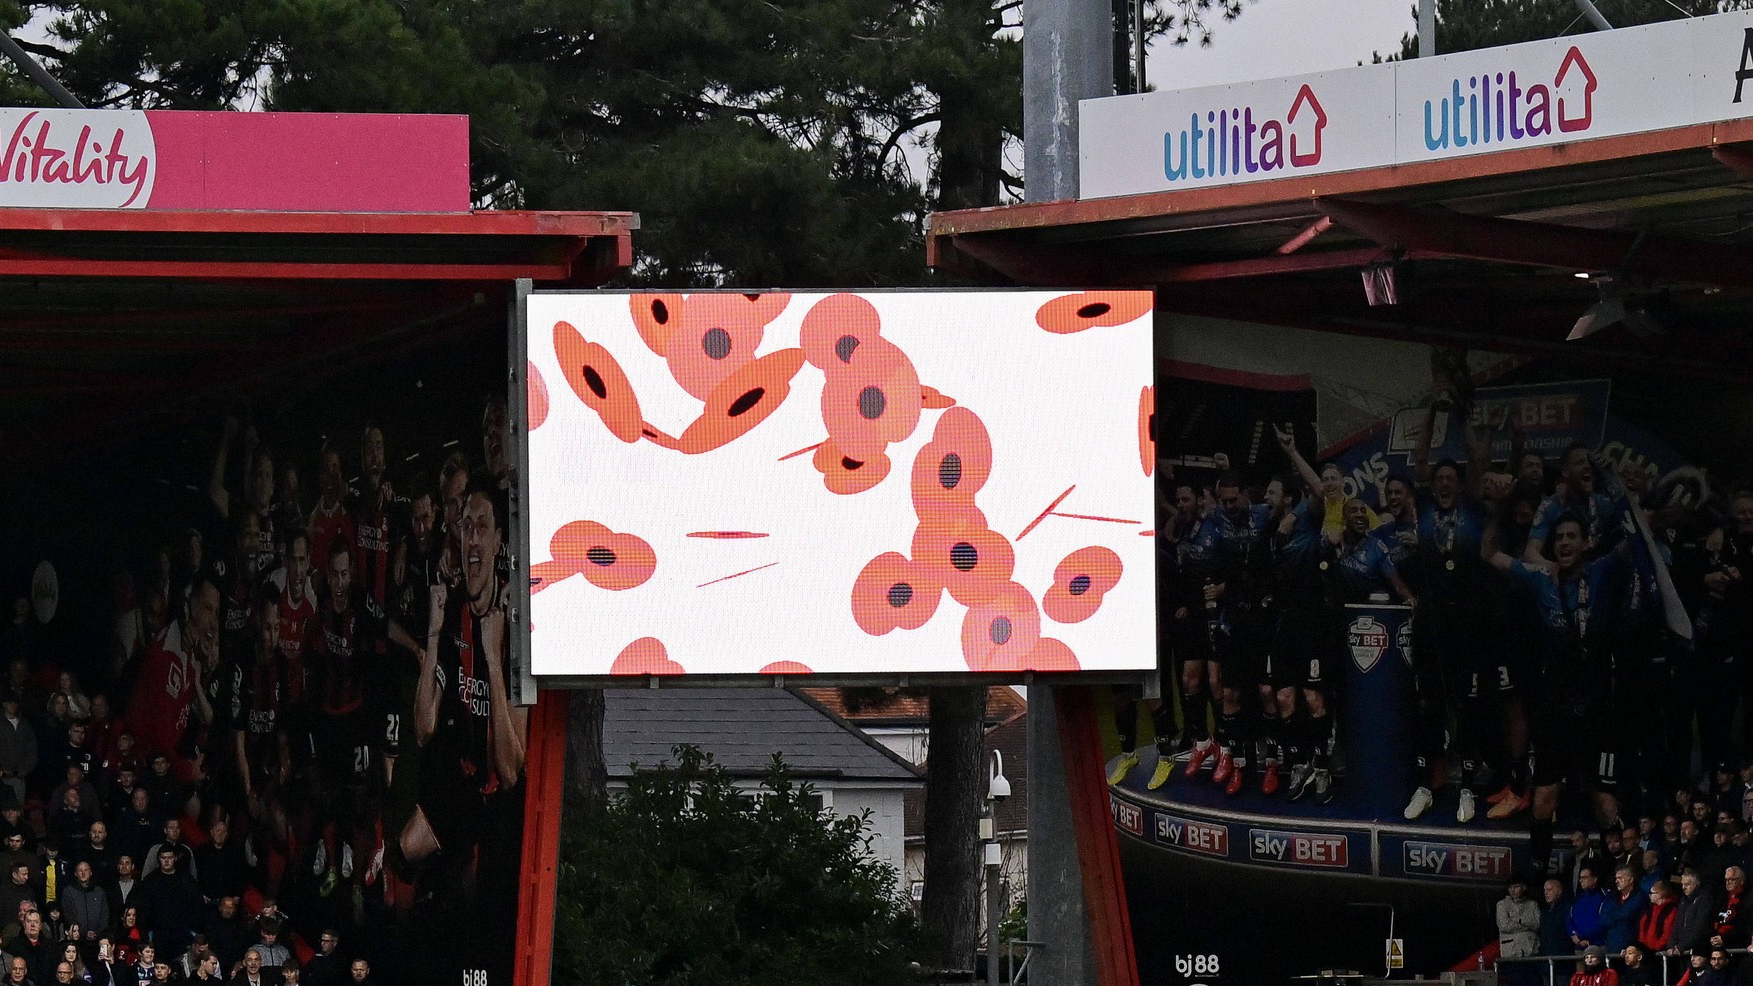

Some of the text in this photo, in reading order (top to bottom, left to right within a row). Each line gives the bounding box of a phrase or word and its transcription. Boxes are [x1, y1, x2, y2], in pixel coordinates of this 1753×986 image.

[1424, 70, 1552, 151] utilita
[1163, 107, 1285, 182] utilita
[1363, 634, 1387, 647] BET
[1119, 803, 1140, 831] BET
[1158, 819, 1223, 852] sky BET
[1255, 833, 1342, 864] sky BET
[1410, 843, 1505, 875] sky BET
[1176, 953, 1219, 978] bj88
